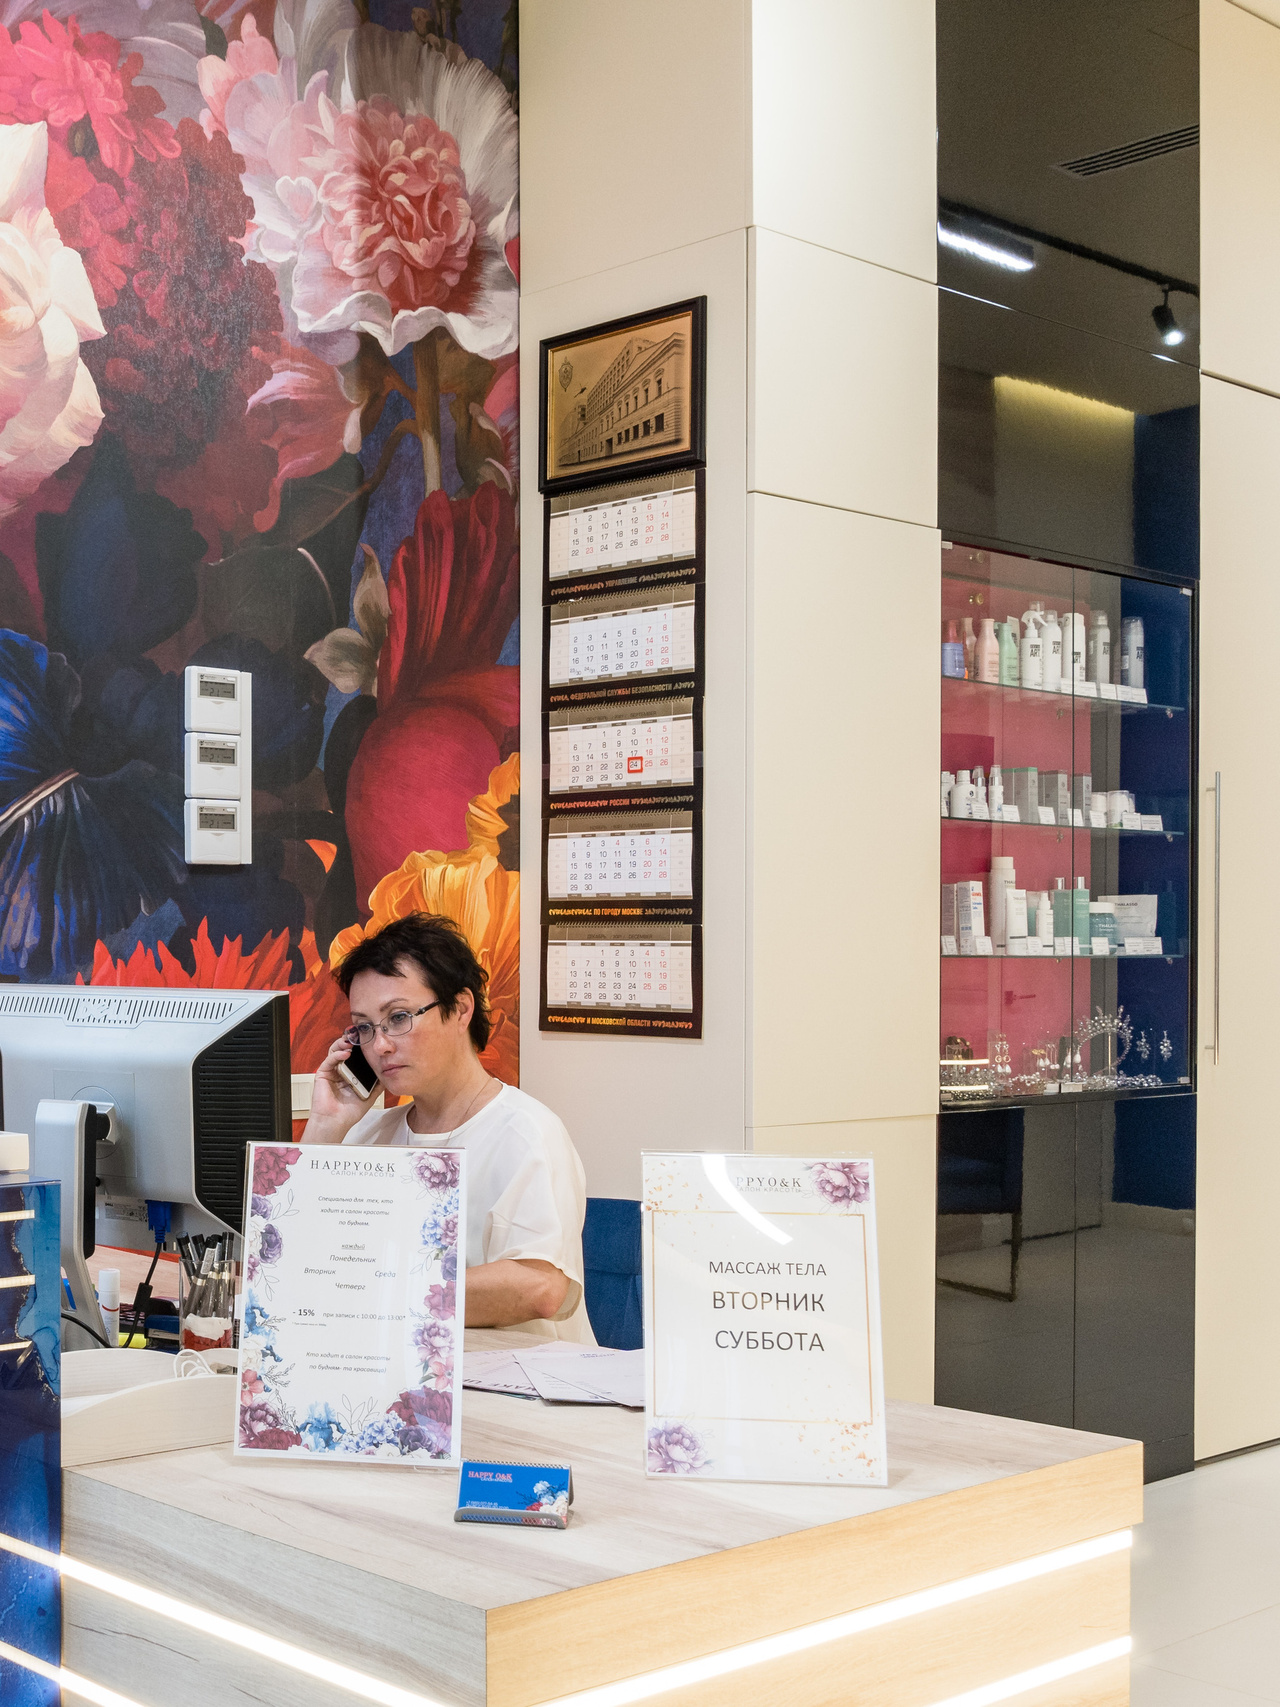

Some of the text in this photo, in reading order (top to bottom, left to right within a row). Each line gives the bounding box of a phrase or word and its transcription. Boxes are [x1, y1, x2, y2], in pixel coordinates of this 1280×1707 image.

[607, 687, 631, 697] СЛУЖБЫ
[572, 754, 580, 762] 13
[586, 753, 594, 761] 14
[600, 752, 609, 760] 15
[661, 747, 669, 755] 19
[571, 765, 580, 773] 20
[601, 908, 621, 916] ГОРОДУ
[583, 981, 592, 989] 21
[658, 983, 667, 991] 26
[598, 992, 607, 1000] 29
[591, 1016, 626, 1026] МОСКОВСКОЙ
[736, 1177, 802, 1187] PPYO&K
[318, 1195, 352, 1203] Специально
[341, 1242, 365, 1250] каждый
[329, 1254, 377, 1263] Понедельник
[304, 1267, 336, 1276] Вторник
[709, 1261, 827, 1276] МАССАЖ ТЕЛА
[374, 1270, 396, 1278] Среда
[335, 1282, 366, 1291] Четверг
[713, 1291, 825, 1312] ВТОРНИК
[298, 1308, 315, 1317] 15%
[715, 1330, 825, 1351] СУББОТА
[468, 1471, 494, 1479] HAPPY
